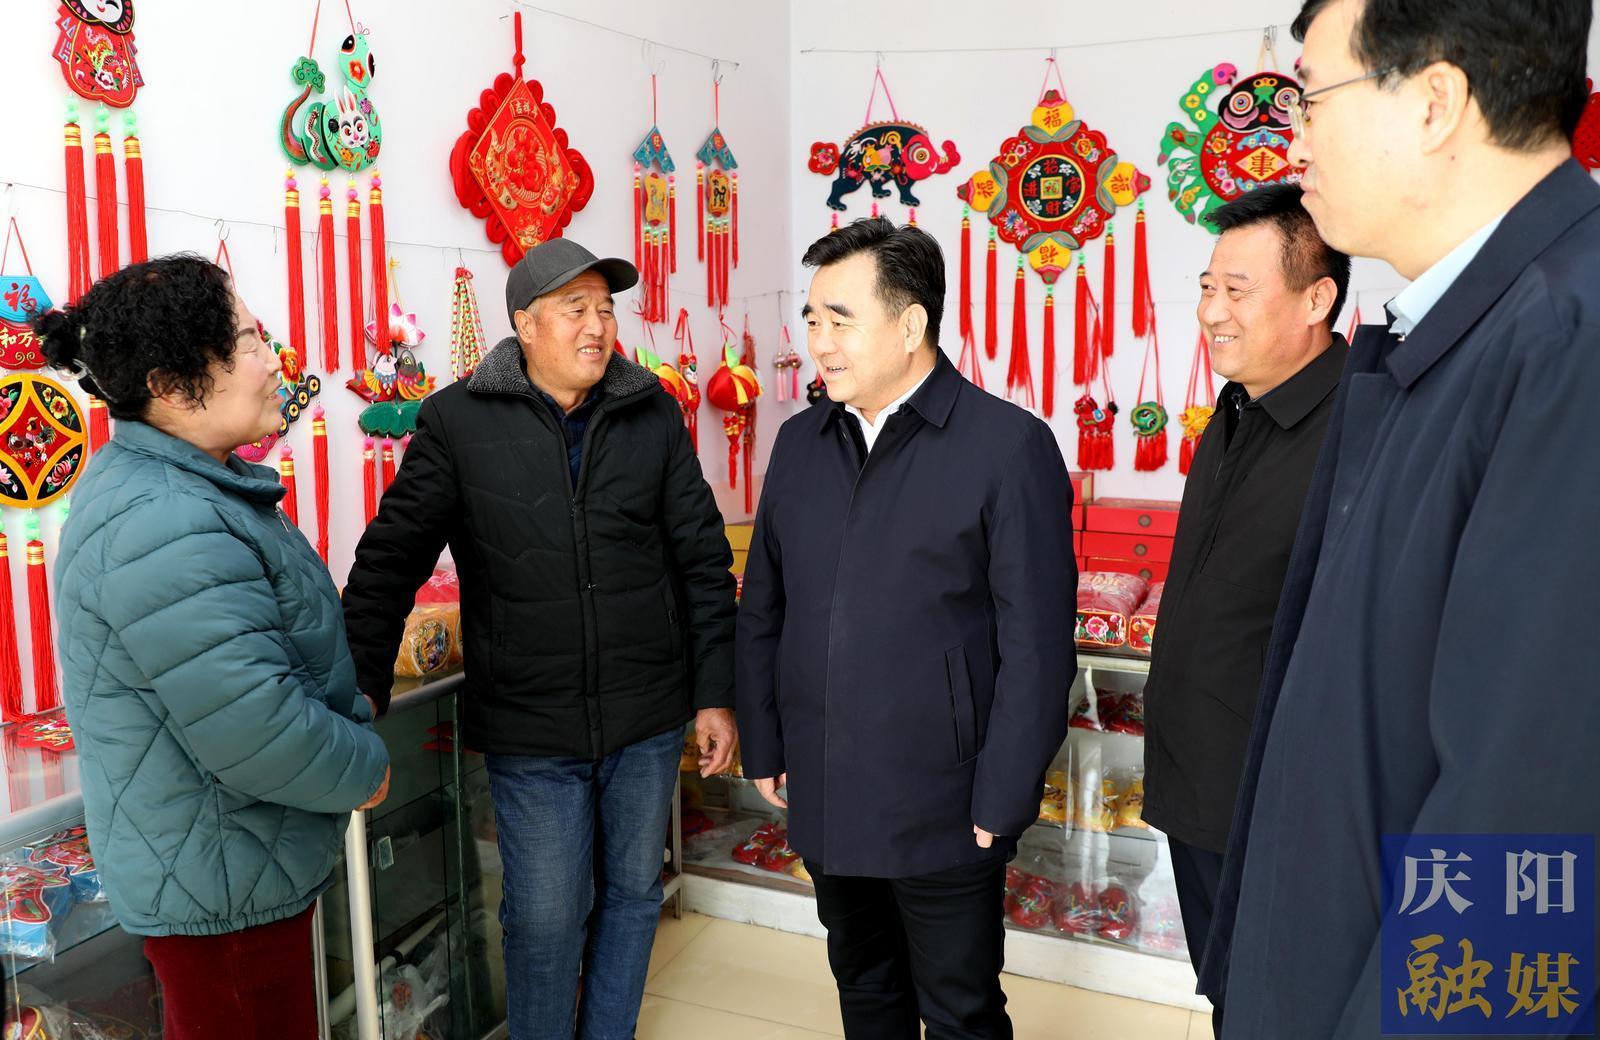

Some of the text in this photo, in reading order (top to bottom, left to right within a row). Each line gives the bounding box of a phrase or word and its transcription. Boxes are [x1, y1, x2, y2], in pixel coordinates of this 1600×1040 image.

[1043, 108, 1062, 128] 福
[977, 179, 994, 198] 福
[1110, 173, 1131, 194] 福
[1039, 244, 1059, 265] 福
[3, 282, 37, 312] 福
